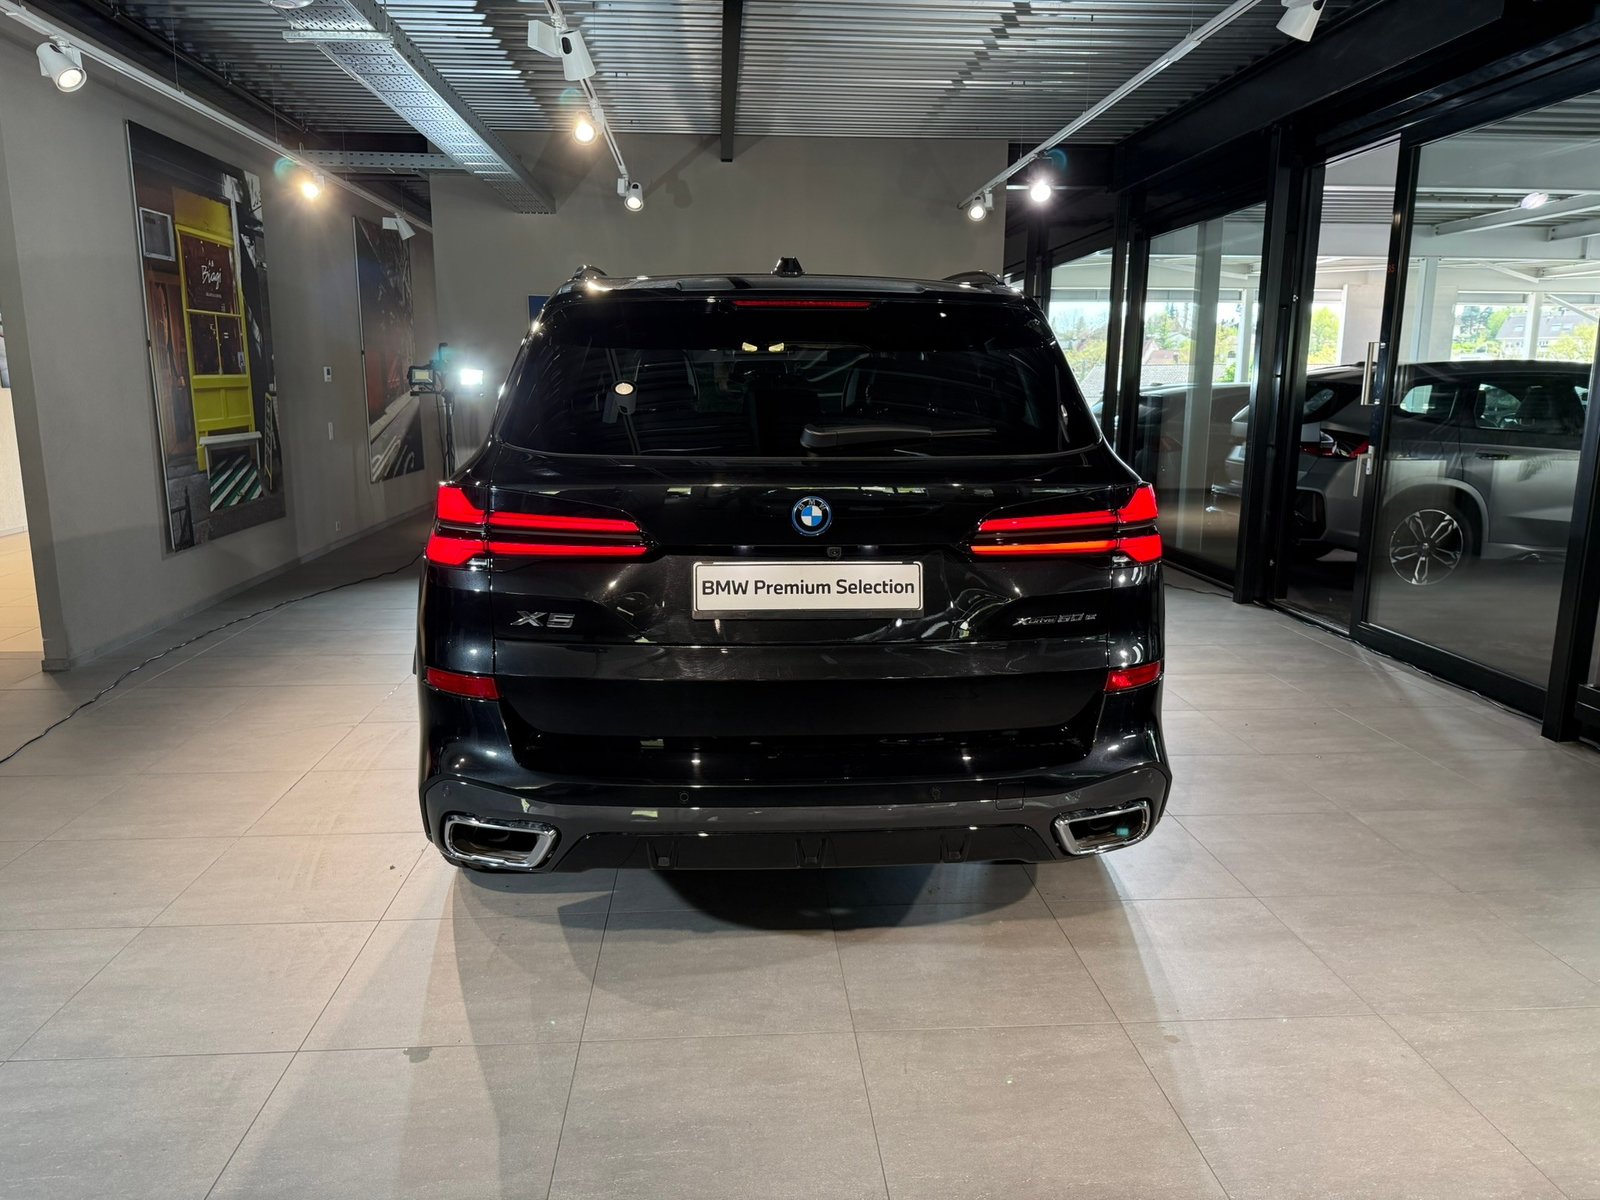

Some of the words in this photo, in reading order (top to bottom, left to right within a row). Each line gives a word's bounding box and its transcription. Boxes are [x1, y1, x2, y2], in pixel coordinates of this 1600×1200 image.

[798, 499, 827, 511] BMW
[702, 579, 749, 596] BMW
[754, 579, 832, 595] Premium
[836, 578, 915, 595] Selection
[510, 610, 576, 628] X5
